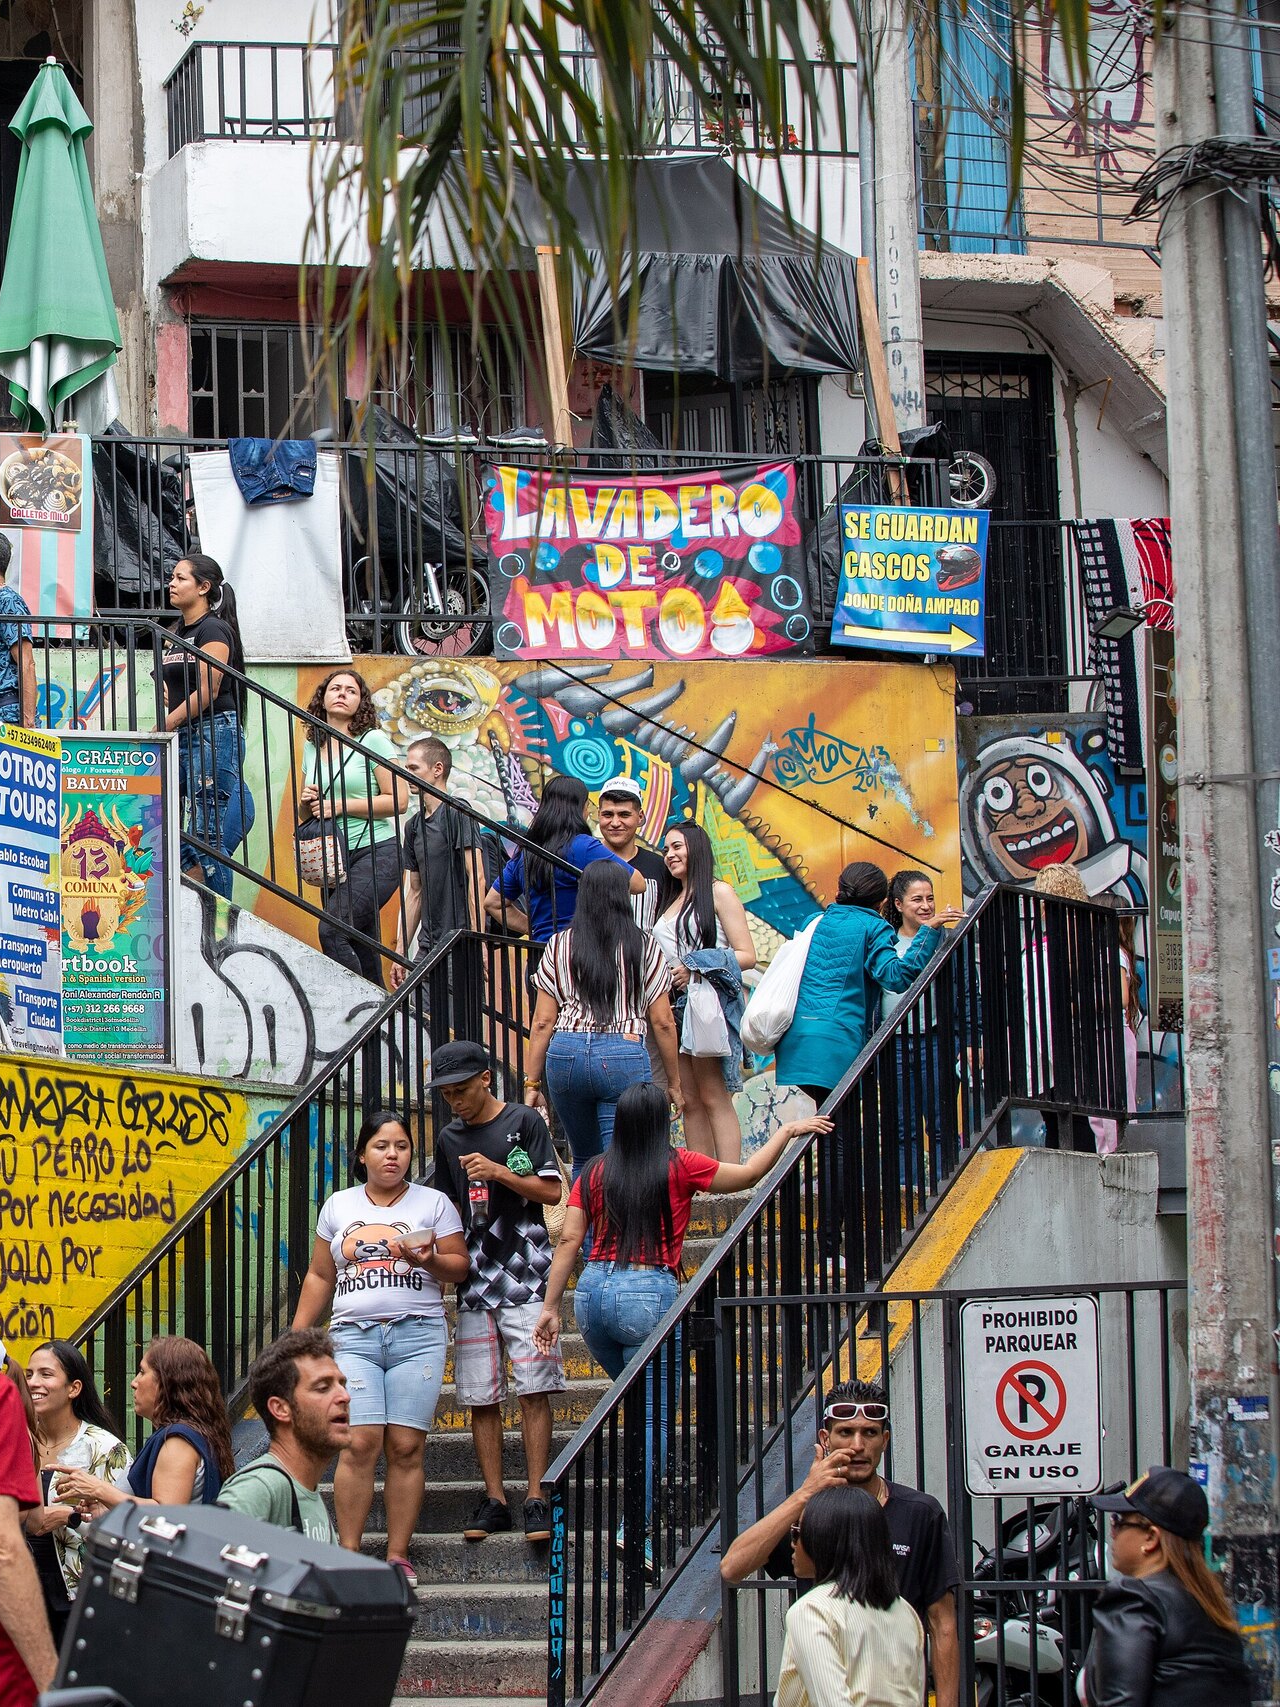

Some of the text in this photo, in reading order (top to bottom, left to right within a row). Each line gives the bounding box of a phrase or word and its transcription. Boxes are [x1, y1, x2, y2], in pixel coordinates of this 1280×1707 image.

[498, 466, 785, 541] LAVADERO
[11, 507, 70, 523] GALLETAS MILO
[844, 511, 979, 544] SE GUARDAN
[595, 543, 657, 590] DE
[844, 551, 931, 582] CASCOS
[843, 592, 980, 617] DONDE DOÑA AMPARO
[523, 580, 756, 655] MOTOS
[7, 730, 57, 752] +57 3234962408
[76, 746, 157, 766] GRÁFICO
[66, 777, 128, 791] BALVIN
[19, 852, 48, 870] Escobar
[72, 847, 110, 881] 13
[12, 885, 55, 905] Comuna 13
[64, 881, 119, 894] COMUNA
[13, 903, 39, 919] Metro
[61, 954, 138, 974] rtbook
[78, 975, 112, 985] Spanish
[17, 989, 58, 1009] Transporte
[79, 989, 120, 999] Alexander
[121, 989, 152, 999] Rendón
[154, 990, 161, 999] R
[64, 1004, 145, 1014] (+57) 312 266 9668
[30, 1013, 56, 1028] Ciudad
[32, 1131, 115, 1186] PERRO
[122, 1134, 152, 1178] LO
[62, 1236, 104, 1284] Por
[336, 1268, 423, 1298] MOSCHINO
[982, 1309, 1078, 1329] PROHIBIDO
[985, 1332, 1078, 1354] PARQUEAR
[984, 1442, 1082, 1458] GARAJE
[988, 1465, 1079, 1480] EN USO
[892, 1543, 911, 1552] NASA
